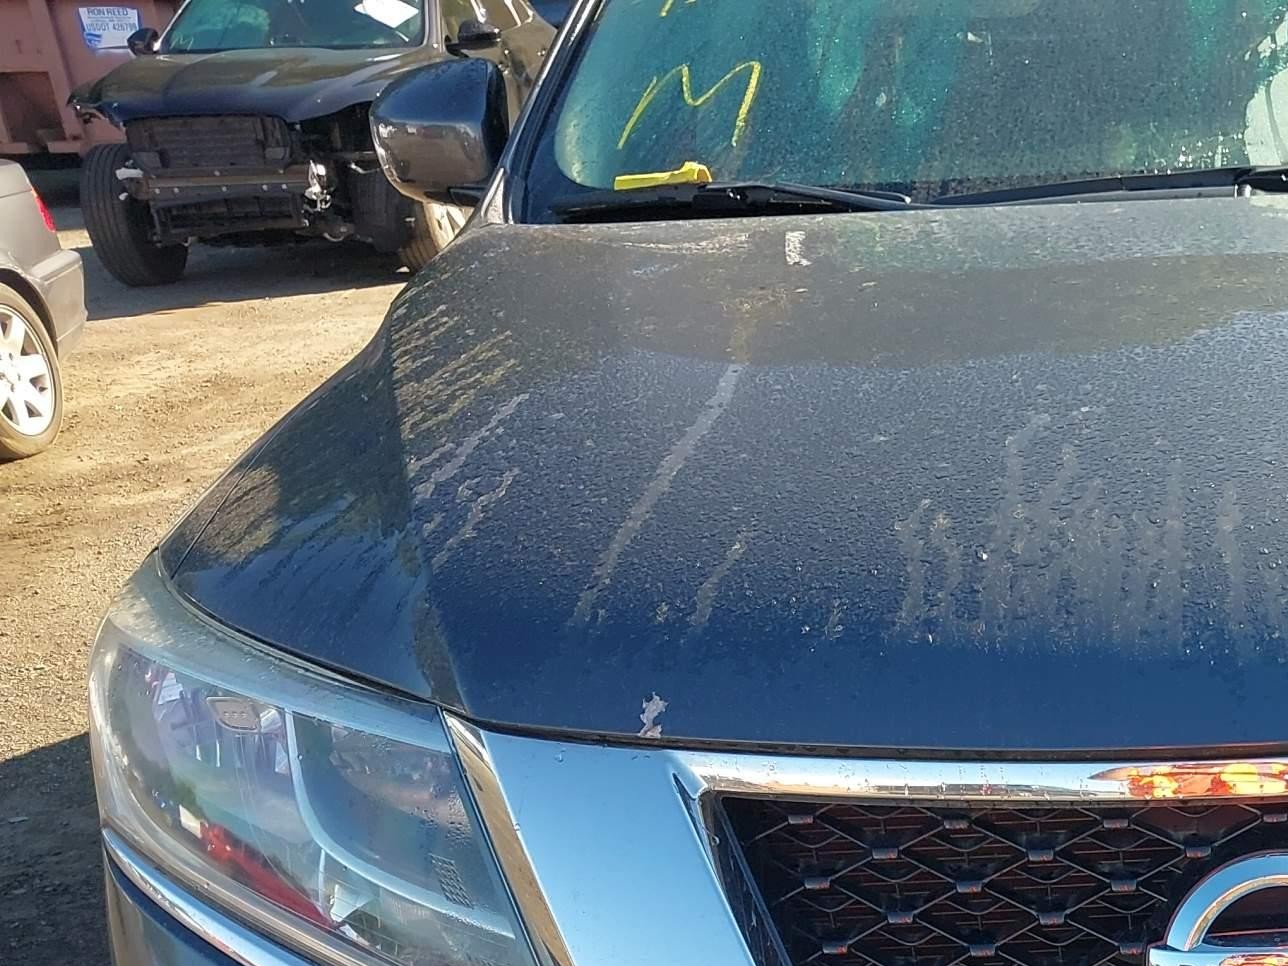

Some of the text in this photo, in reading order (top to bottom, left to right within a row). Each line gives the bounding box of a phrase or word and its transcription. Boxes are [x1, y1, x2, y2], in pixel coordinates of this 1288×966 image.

[87, 7, 129, 17] RON REED
[86, 22, 110, 32] USDOT
